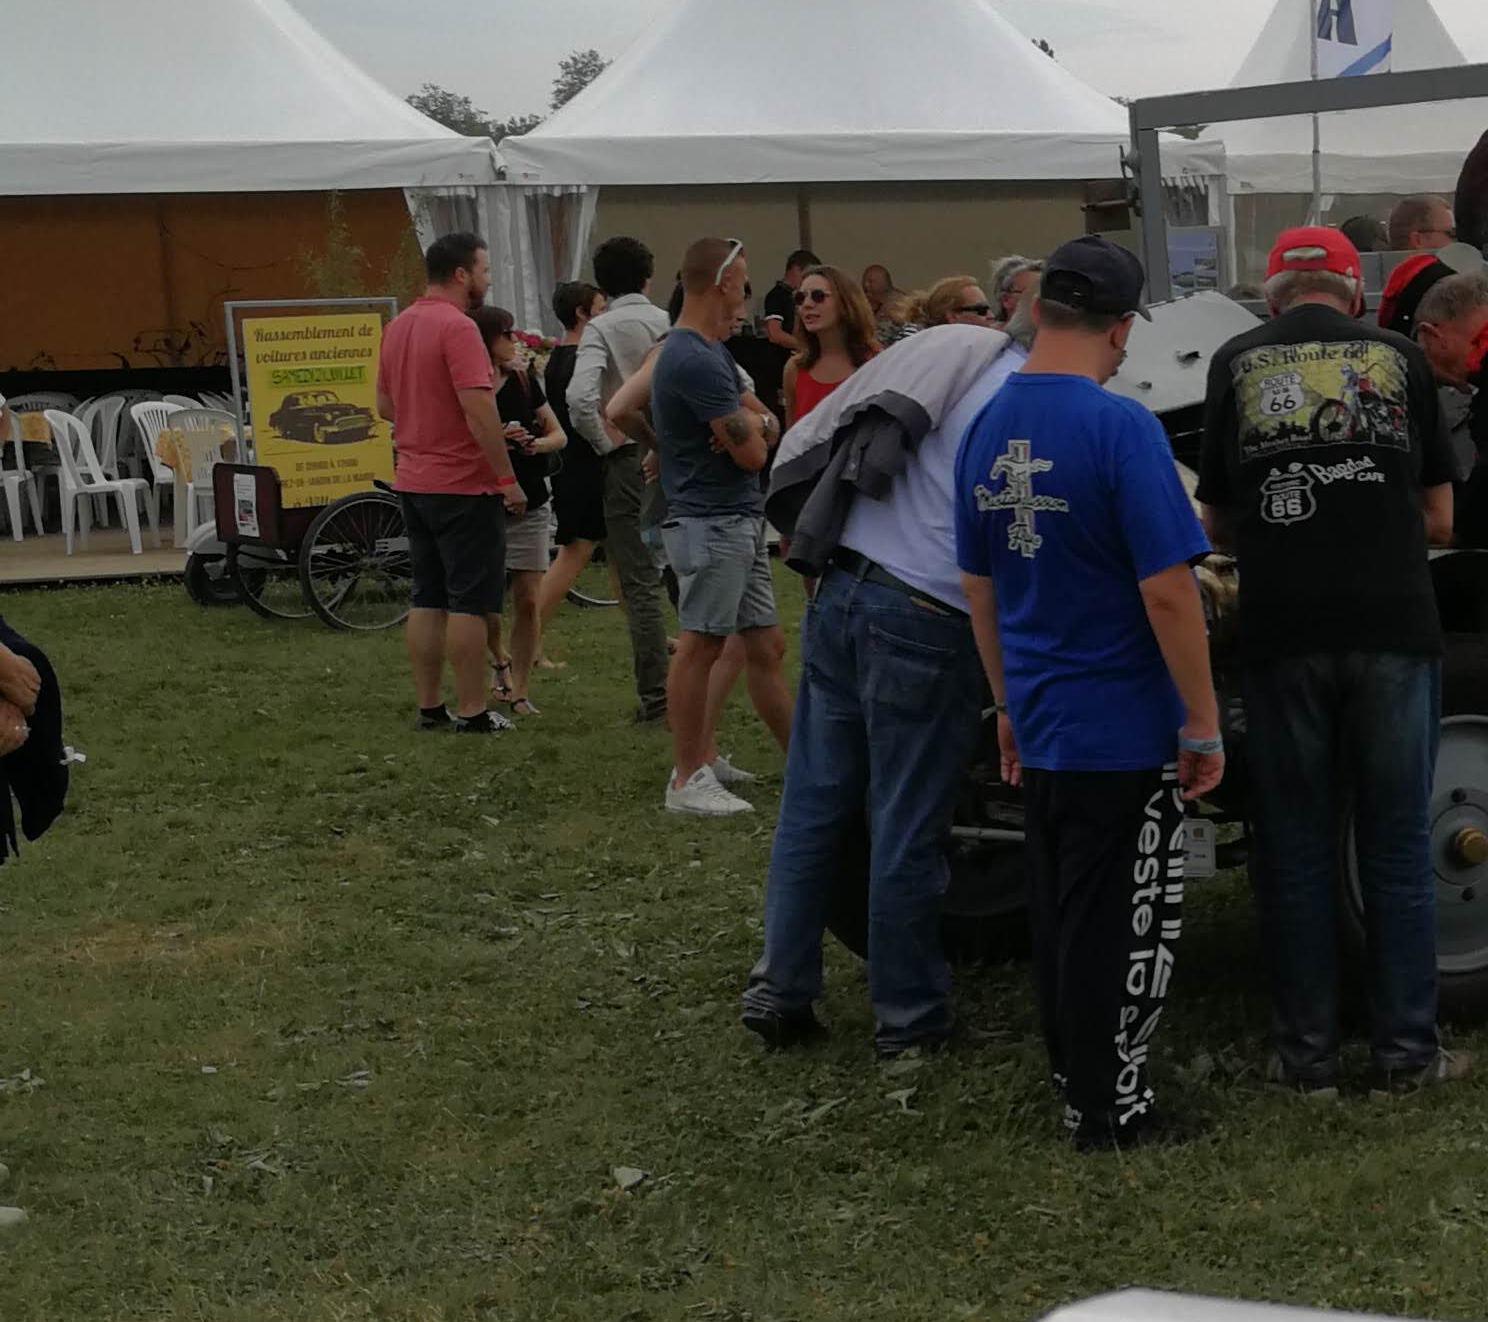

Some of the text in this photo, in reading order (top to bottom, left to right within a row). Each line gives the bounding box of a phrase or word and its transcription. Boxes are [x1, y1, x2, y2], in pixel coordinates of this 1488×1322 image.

[254, 324, 374, 342] Rassemblement de
[255, 346, 373, 364] voitures anciennes
[1283, 345, 1337, 365] Route
[1270, 394, 1297, 413] 66
[1307, 456, 1376, 485] Bagdad
[1271, 499, 1303, 518] 66
[1132, 789, 1164, 937] veste
